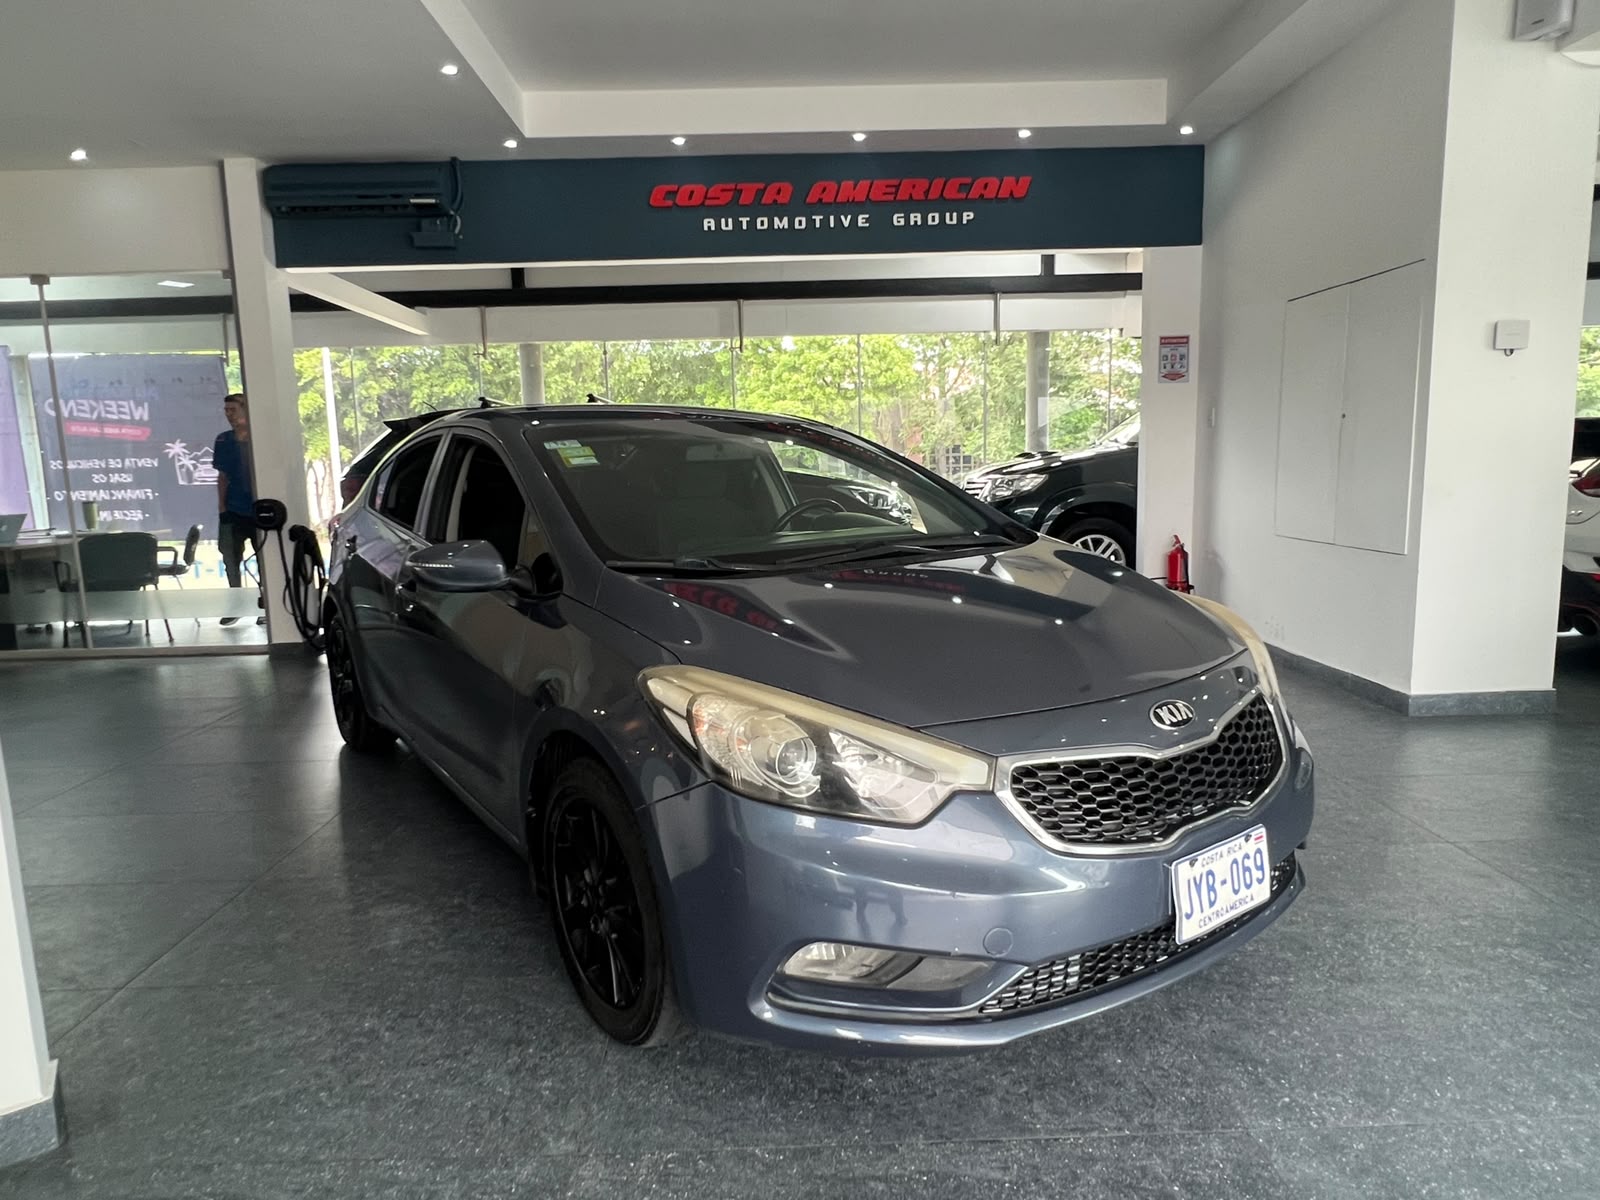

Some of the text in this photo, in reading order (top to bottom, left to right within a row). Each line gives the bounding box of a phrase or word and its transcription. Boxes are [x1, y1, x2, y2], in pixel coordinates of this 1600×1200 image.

[649, 176, 1033, 207] COSTA AMERICAN
[703, 211, 976, 231] AUTOMOTIVE GROUP
[1155, 703, 1193, 725] KIA
[1201, 843, 1243, 867] COSTA RICA
[1184, 847, 1266, 920] JYB-069
[1198, 893, 1255, 929] CENTROAMERICA
